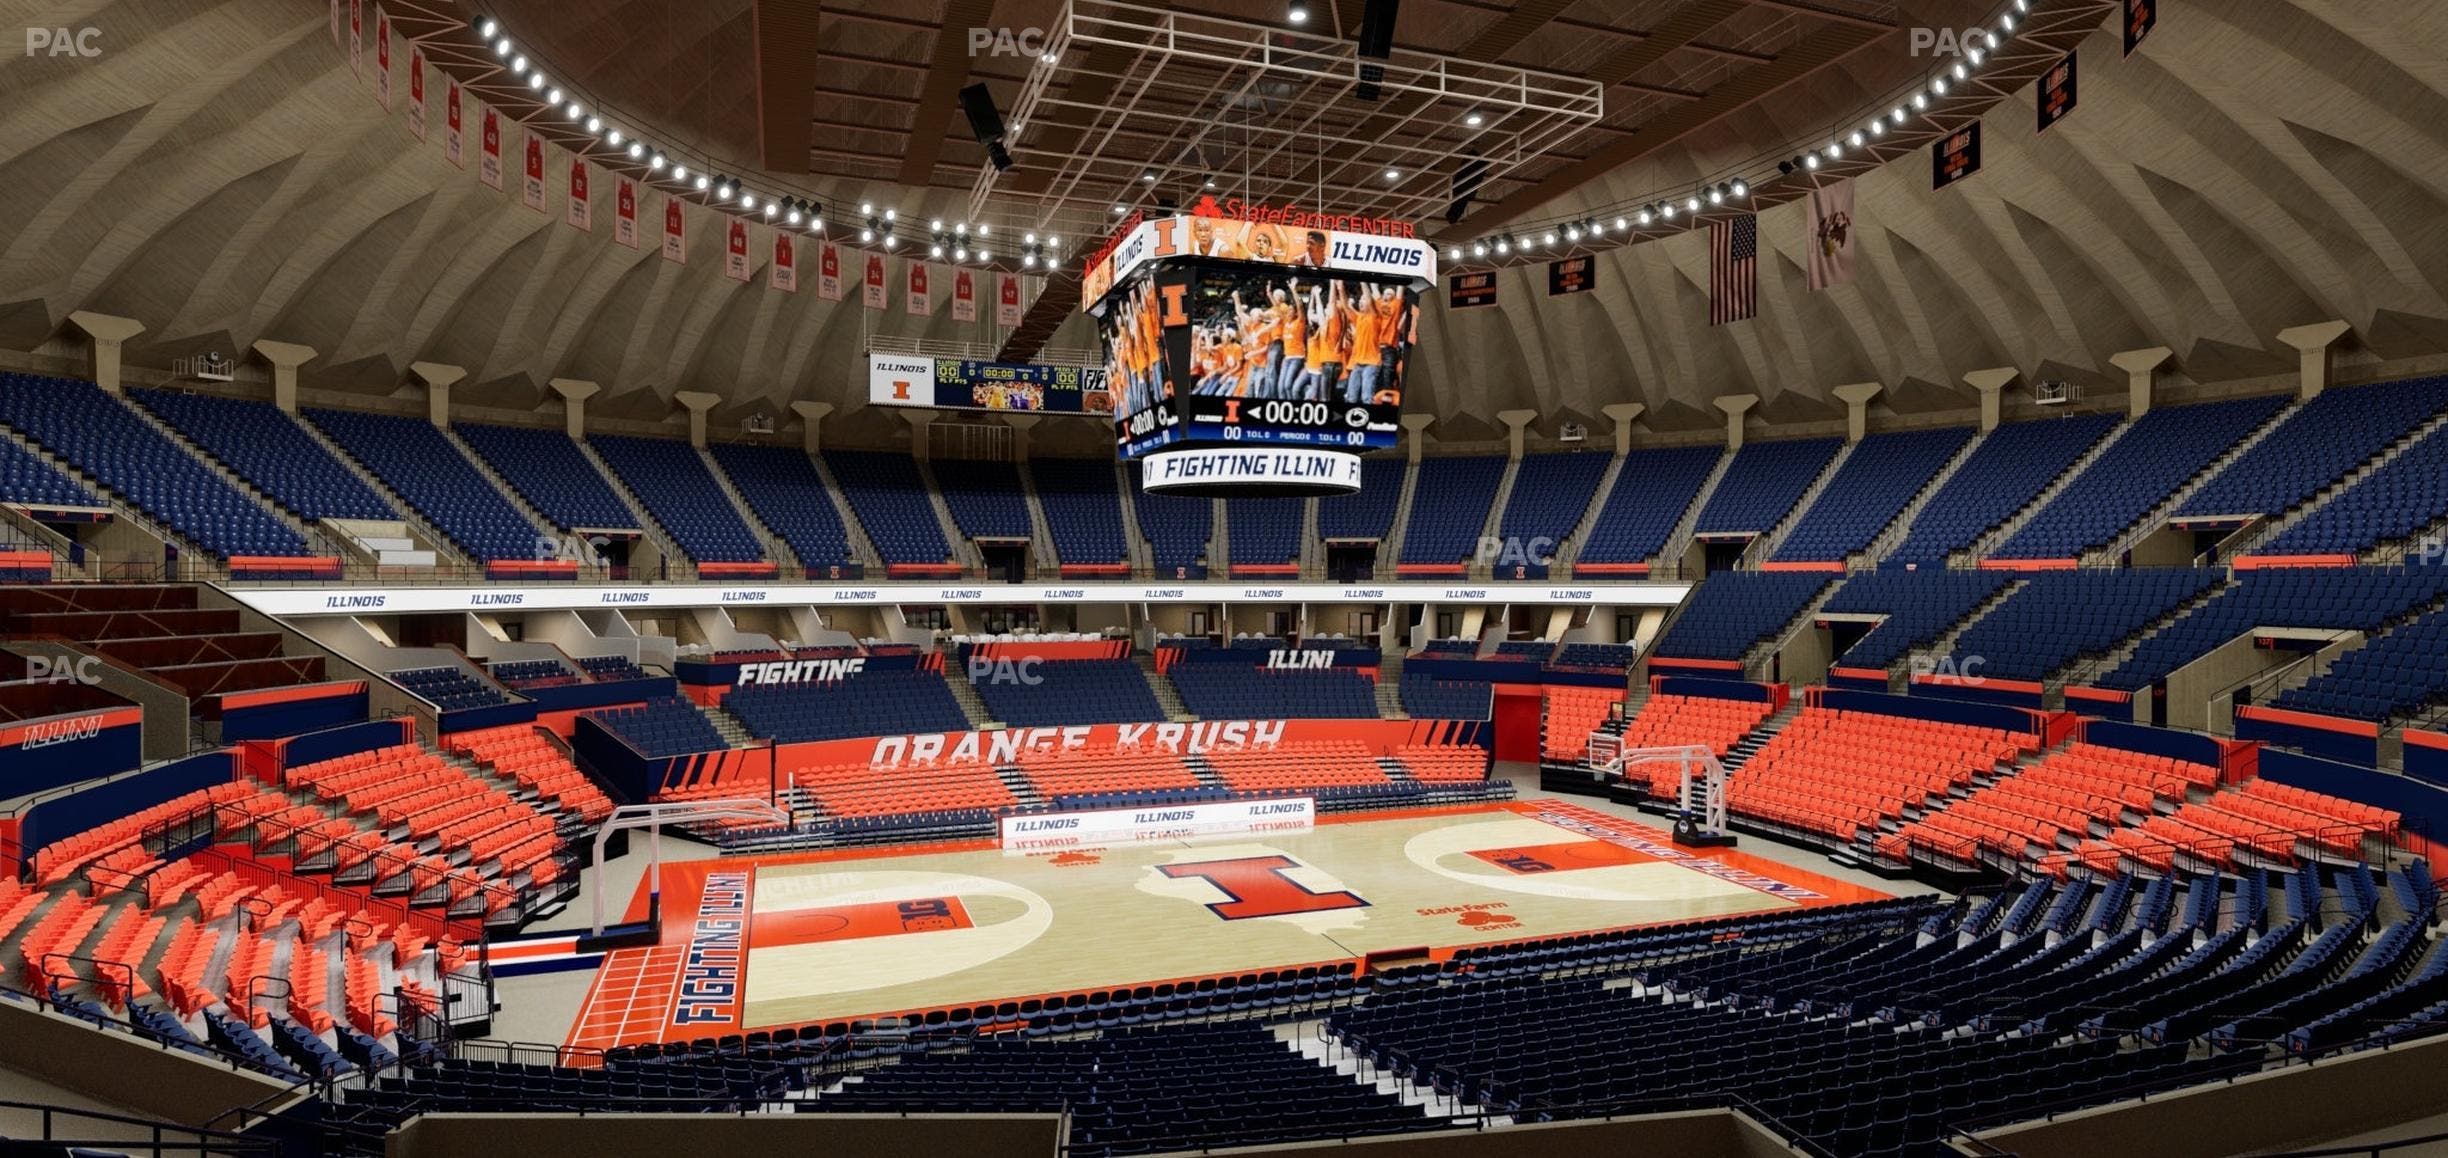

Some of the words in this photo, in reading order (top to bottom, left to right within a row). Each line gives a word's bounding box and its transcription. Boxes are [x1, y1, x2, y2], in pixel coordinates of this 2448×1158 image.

[1116, 235, 1143, 272] ILLINOIS
[1332, 240, 1422, 266] ILLINOIS
[876, 363, 927, 374] ILLINOIS
[1265, 401, 1328, 425] 00:00
[1224, 426, 1241, 440] 00
[1347, 431, 1364, 445] 00
[1164, 455, 1267, 478] FIGHTING
[1273, 455, 1336, 478] ILLINI
[472, 594, 523, 605] ILLINOIS
[602, 592, 649, 602] ILLINOIS
[722, 591, 766, 601] ILLINOIS
[834, 590, 877, 600] ILLINOIS
[941, 590, 982, 599] ILLINOIS
[1044, 590, 1084, 599] ILLINOIS
[1145, 590, 1184, 598] ILLINOIS
[1244, 590, 1283, 598] ILLINOIS
[1344, 590, 1384, 598] ILLINOIS
[1445, 590, 1486, 599] ILLINOIS
[1550, 591, 1592, 599] ILLINOIS
[327, 596, 385, 608] ILLINOIS
[1268, 650, 1334, 669] ILLINI
[22, 714, 104, 750] ILLINI
[1116, 719, 1286, 754] KRUSH
[1250, 803, 1306, 815] ILLINOIS
[1135, 810, 1195, 823] ILLINOIS
[1015, 818, 1080, 832] ILLINOIS
[698, 872, 748, 917] ILLINI
[672, 919, 744, 1026] FIGHTING
